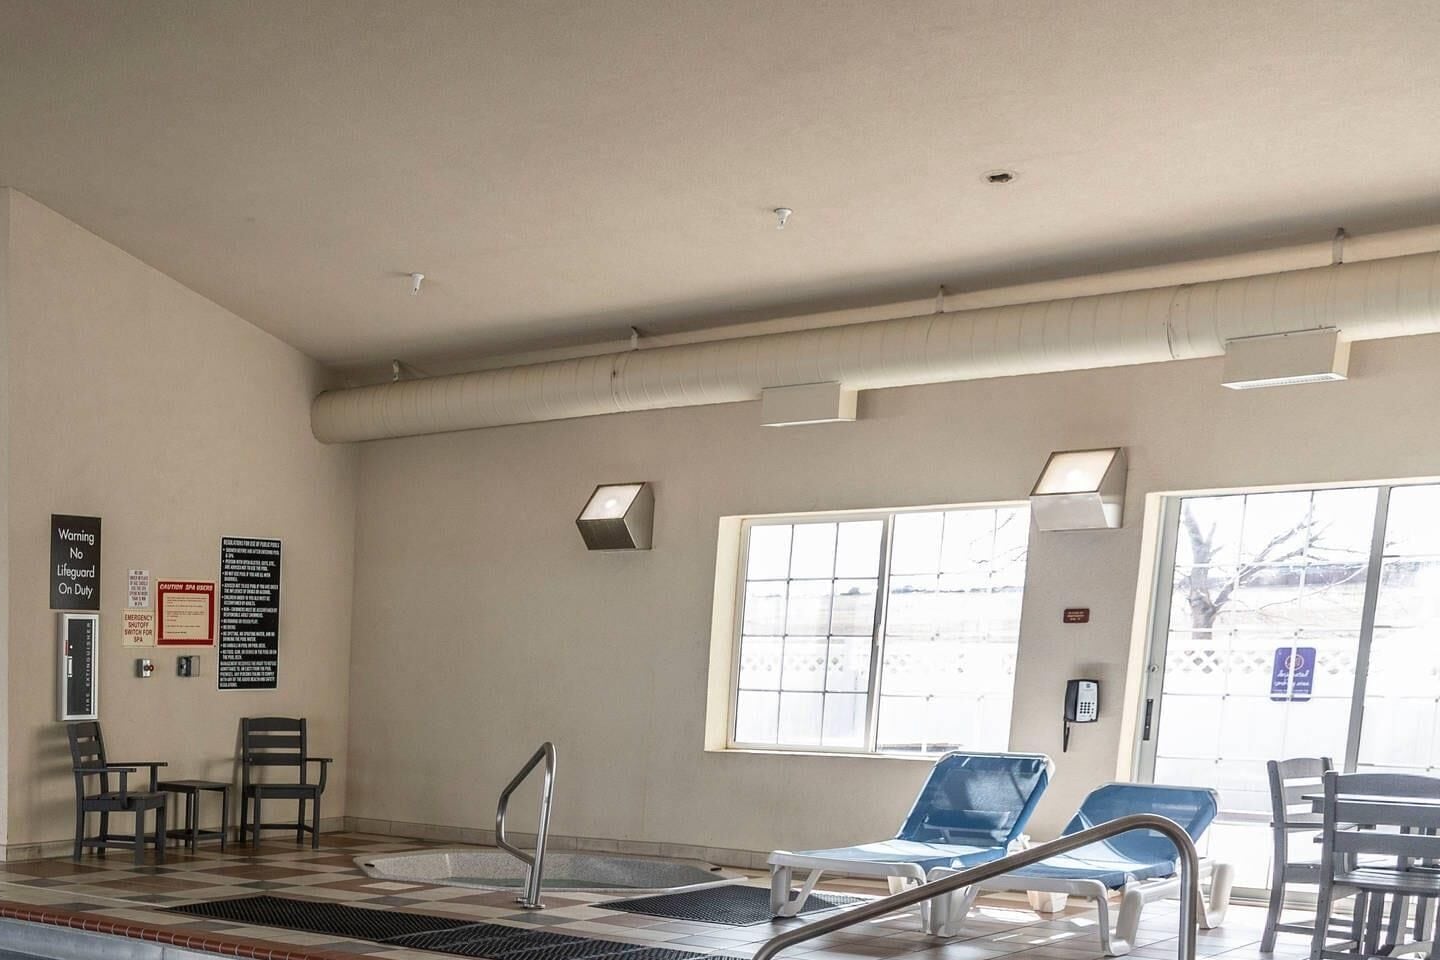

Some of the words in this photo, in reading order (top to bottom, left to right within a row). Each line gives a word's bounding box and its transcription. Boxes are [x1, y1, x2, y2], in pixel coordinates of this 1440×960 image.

[58, 528, 95, 546] Warning
[69, 547, 83, 560] No
[57, 563, 95, 580] Lifeguard
[58, 582, 72, 595] On
[74, 583, 93, 599] Duty
[159, 583, 184, 591] CAUTION
